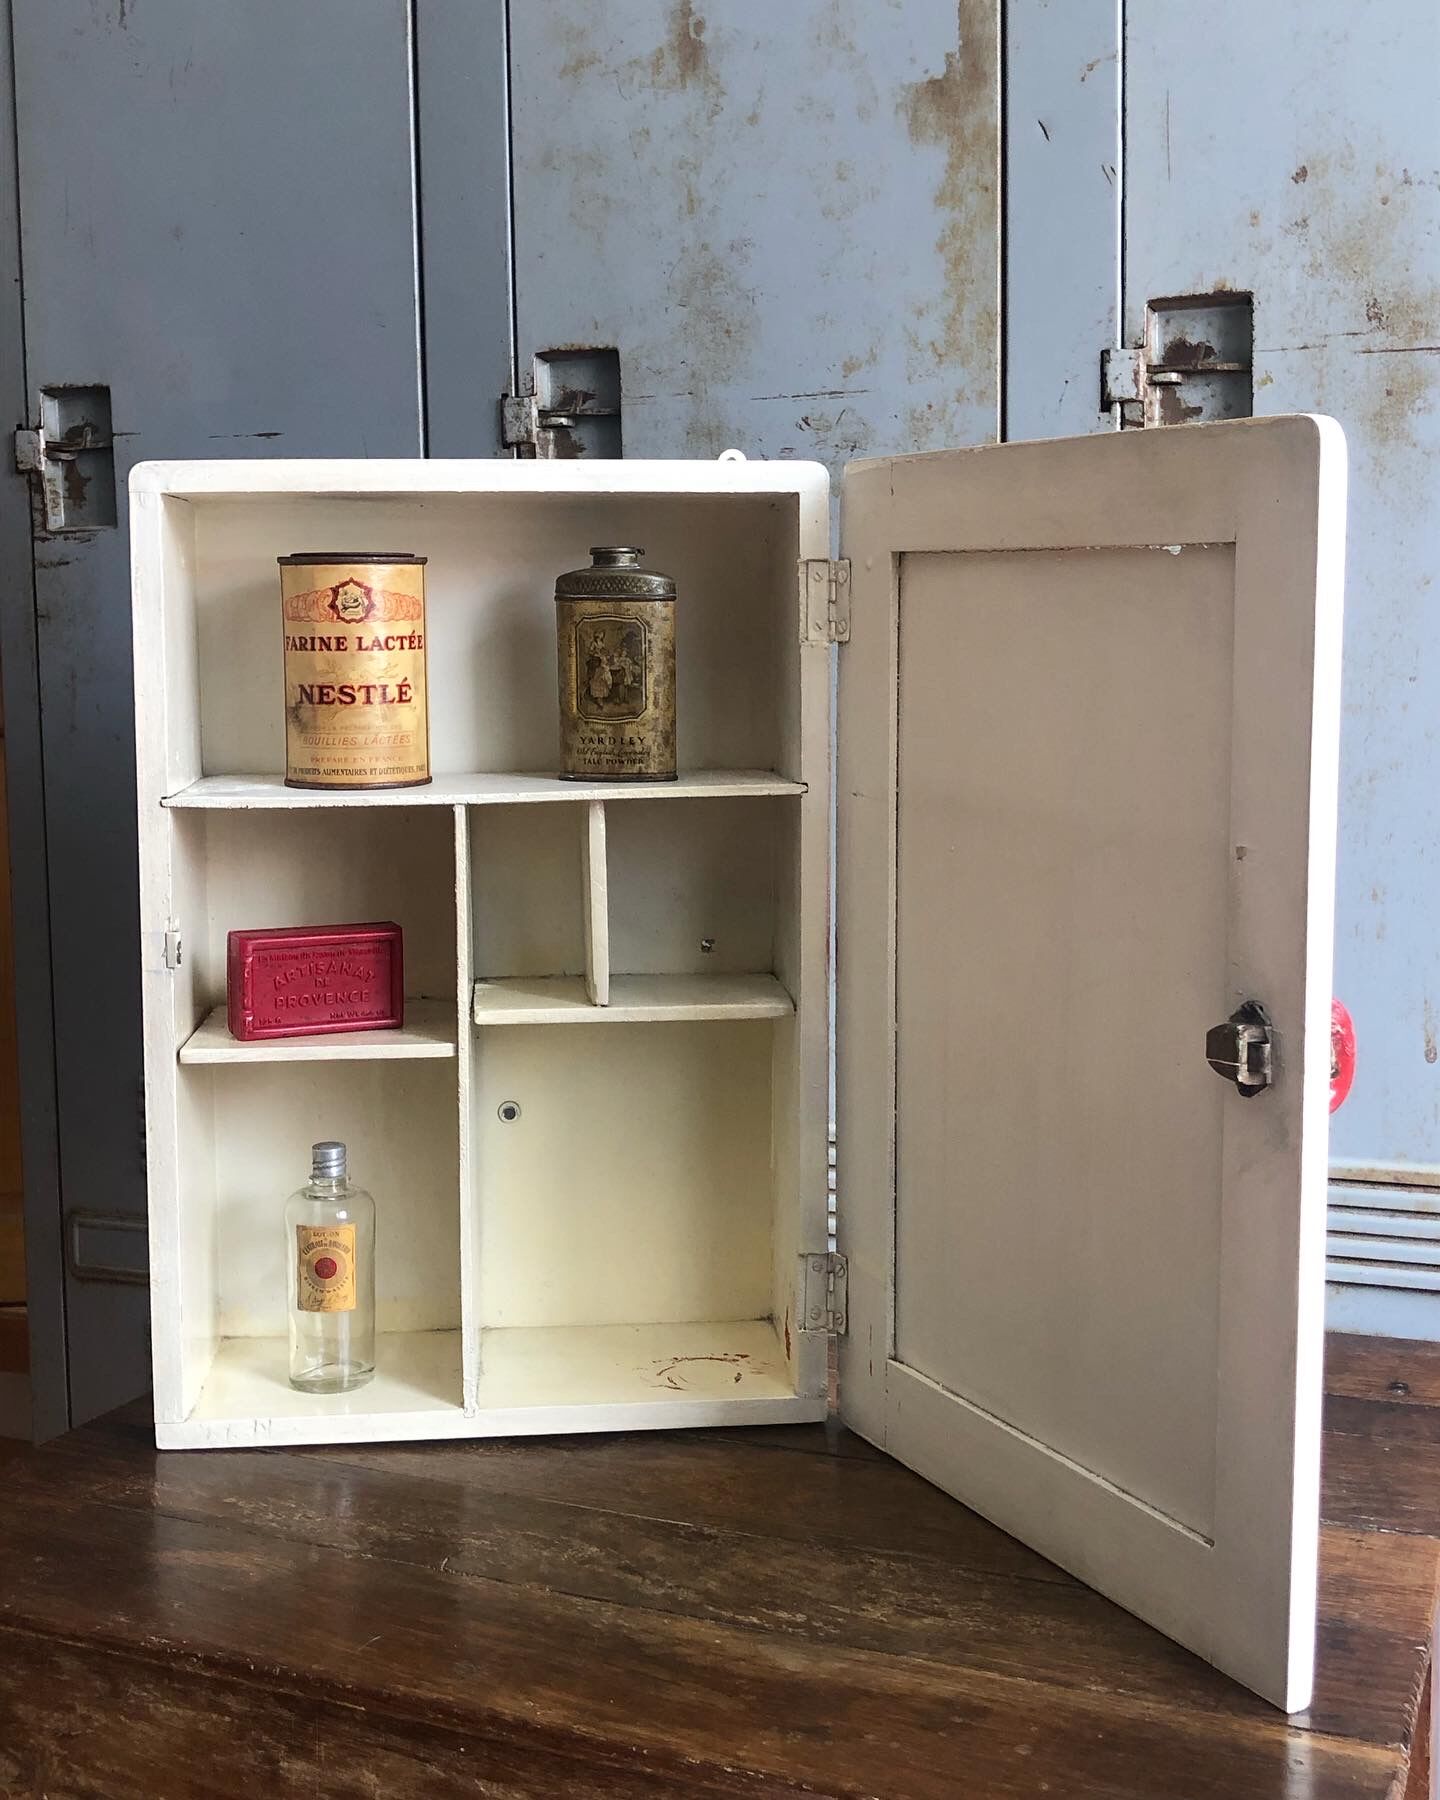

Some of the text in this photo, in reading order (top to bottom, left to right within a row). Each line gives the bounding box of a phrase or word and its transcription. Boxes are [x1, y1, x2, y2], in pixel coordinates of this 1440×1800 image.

[285, 630, 423, 652] FARINE LACTÉE
[298, 677, 413, 706] NESTLÉ
[580, 737, 647, 746] YARDLEY
[274, 990, 370, 1010] PROVENCE
